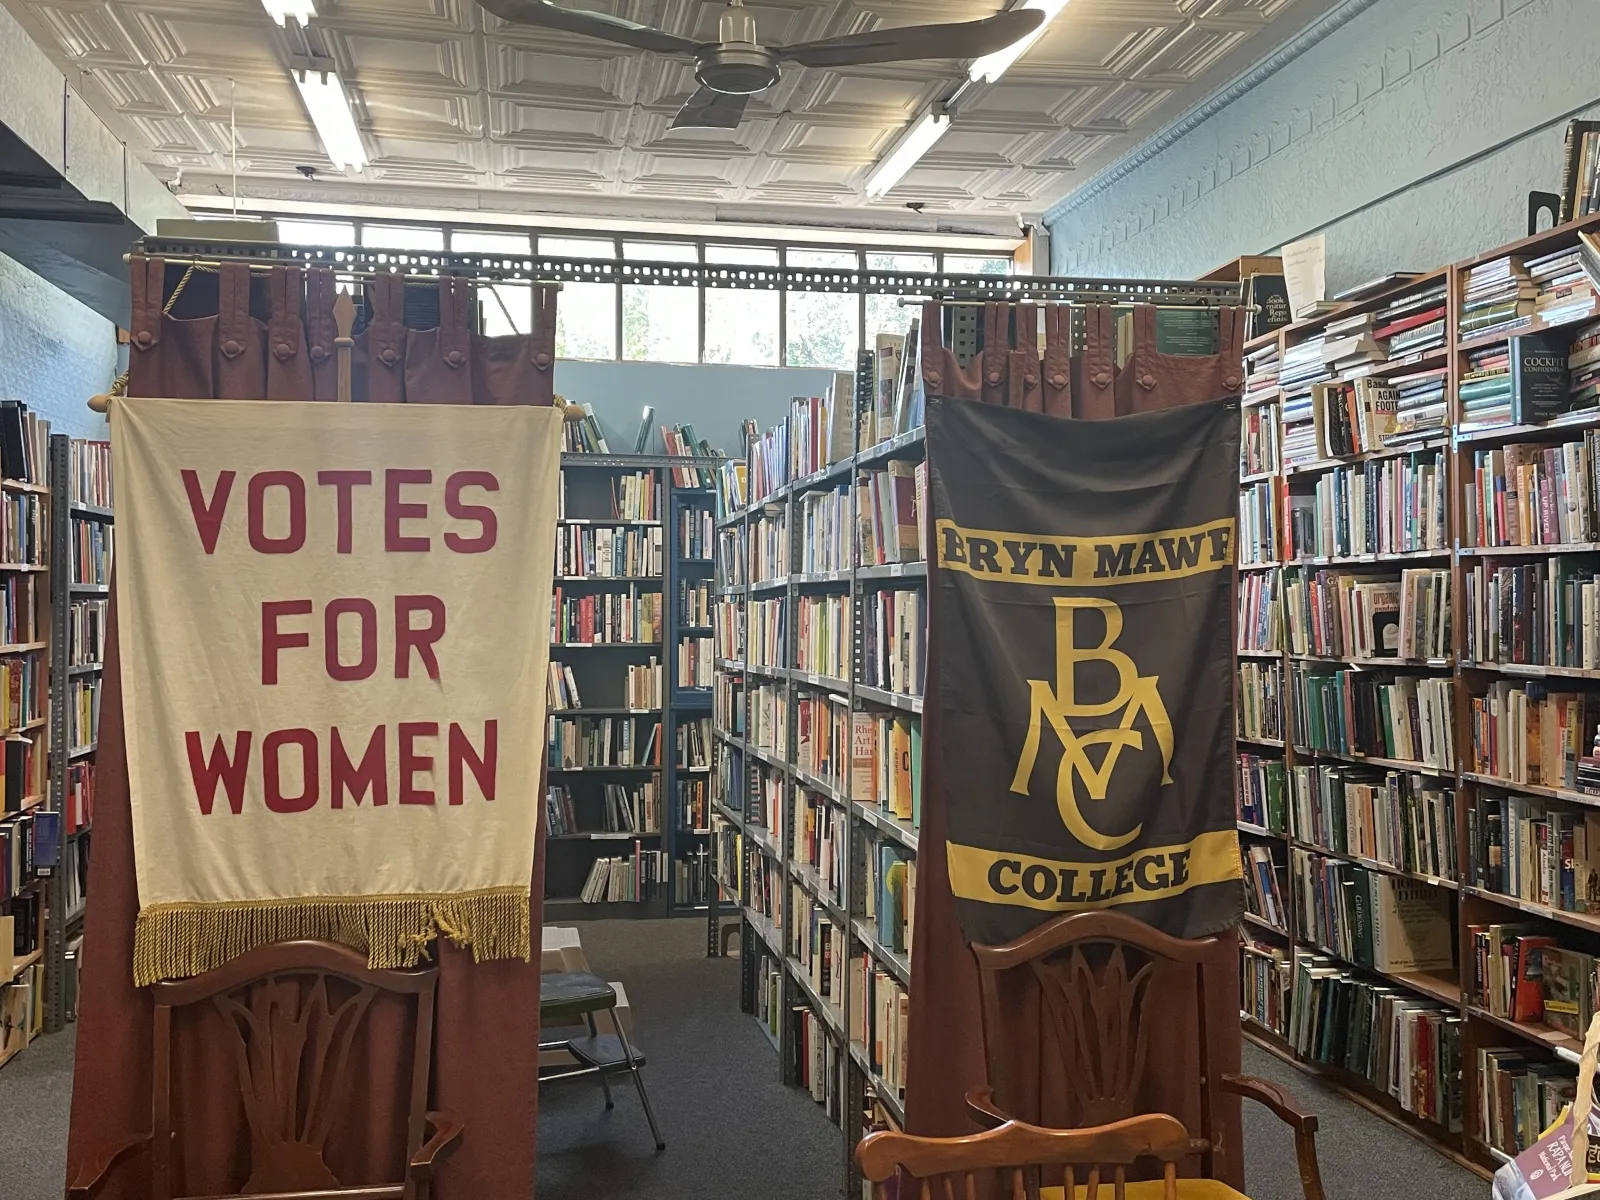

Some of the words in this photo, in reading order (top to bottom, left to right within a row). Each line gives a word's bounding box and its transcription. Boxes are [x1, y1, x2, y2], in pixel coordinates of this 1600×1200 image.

[1524, 357, 1564, 366] COCKPIT
[180, 468, 500, 554] VOTES
[1542, 496, 1548, 508] UP
[943, 527, 1077, 578] BRYN
[1373, 591, 1399, 605] organic
[262, 594, 446, 685] FOR
[185, 719, 498, 815] WOMEN
[987, 848, 1192, 903] COLLEGE
[1355, 894, 1363, 938] GARDENING
[1547, 1141, 1567, 1166] RAPA
